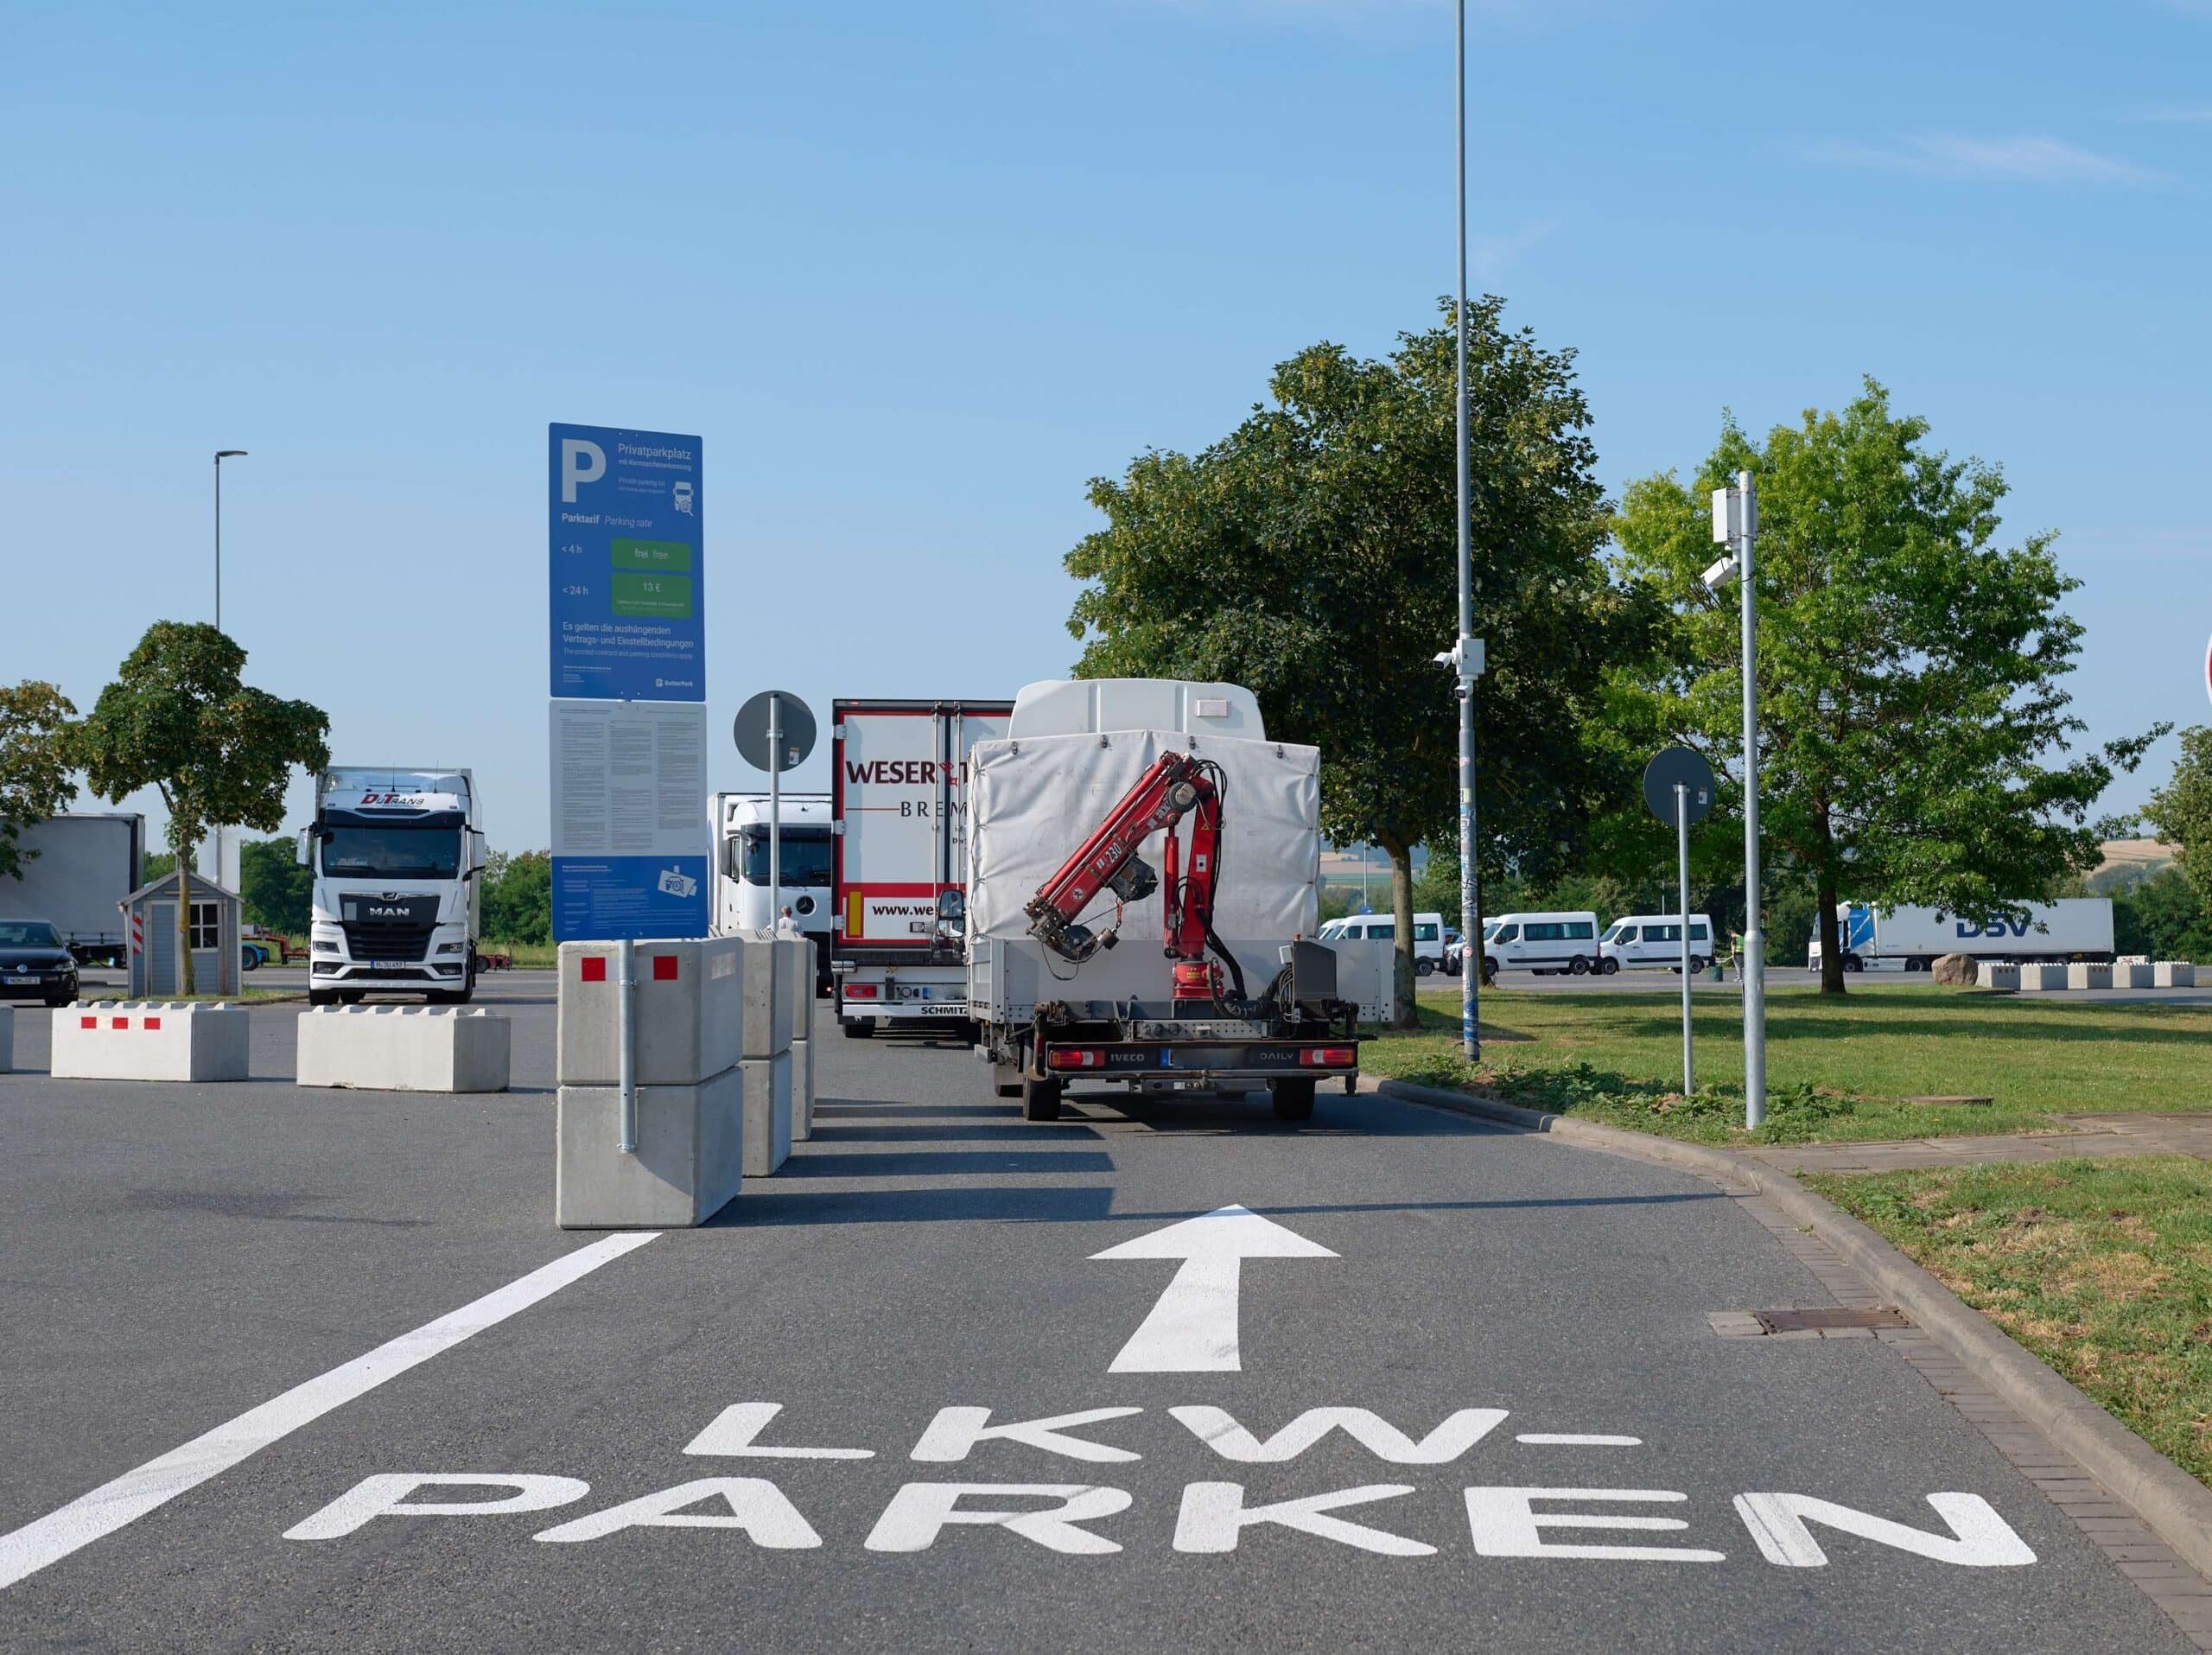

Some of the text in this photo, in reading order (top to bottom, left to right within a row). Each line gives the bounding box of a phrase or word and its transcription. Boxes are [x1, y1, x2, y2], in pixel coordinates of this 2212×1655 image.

[618, 442, 691, 460] Privatparkplatz
[562, 438, 607, 503] P
[562, 513, 653, 528] Parktarif Parking rate
[576, 545, 582, 554] h
[635, 549, 669, 560] frei free
[569, 586, 582, 595] 24
[582, 587, 588, 595] h
[643, 582, 661, 593] 13 €
[563, 622, 671, 636] Es gelten die aushängenden
[563, 634, 694, 650] Vertrags- und Einstellbedingungen
[845, 761, 939, 784] WESER
[1106, 843, 1122, 864] 230
[369, 907, 410, 916] MAN
[1956, 912, 2032, 938] DSV
[1110, 1053, 1145, 1062] IVECO
[282, 1472, 2037, 1569] PARKEN
